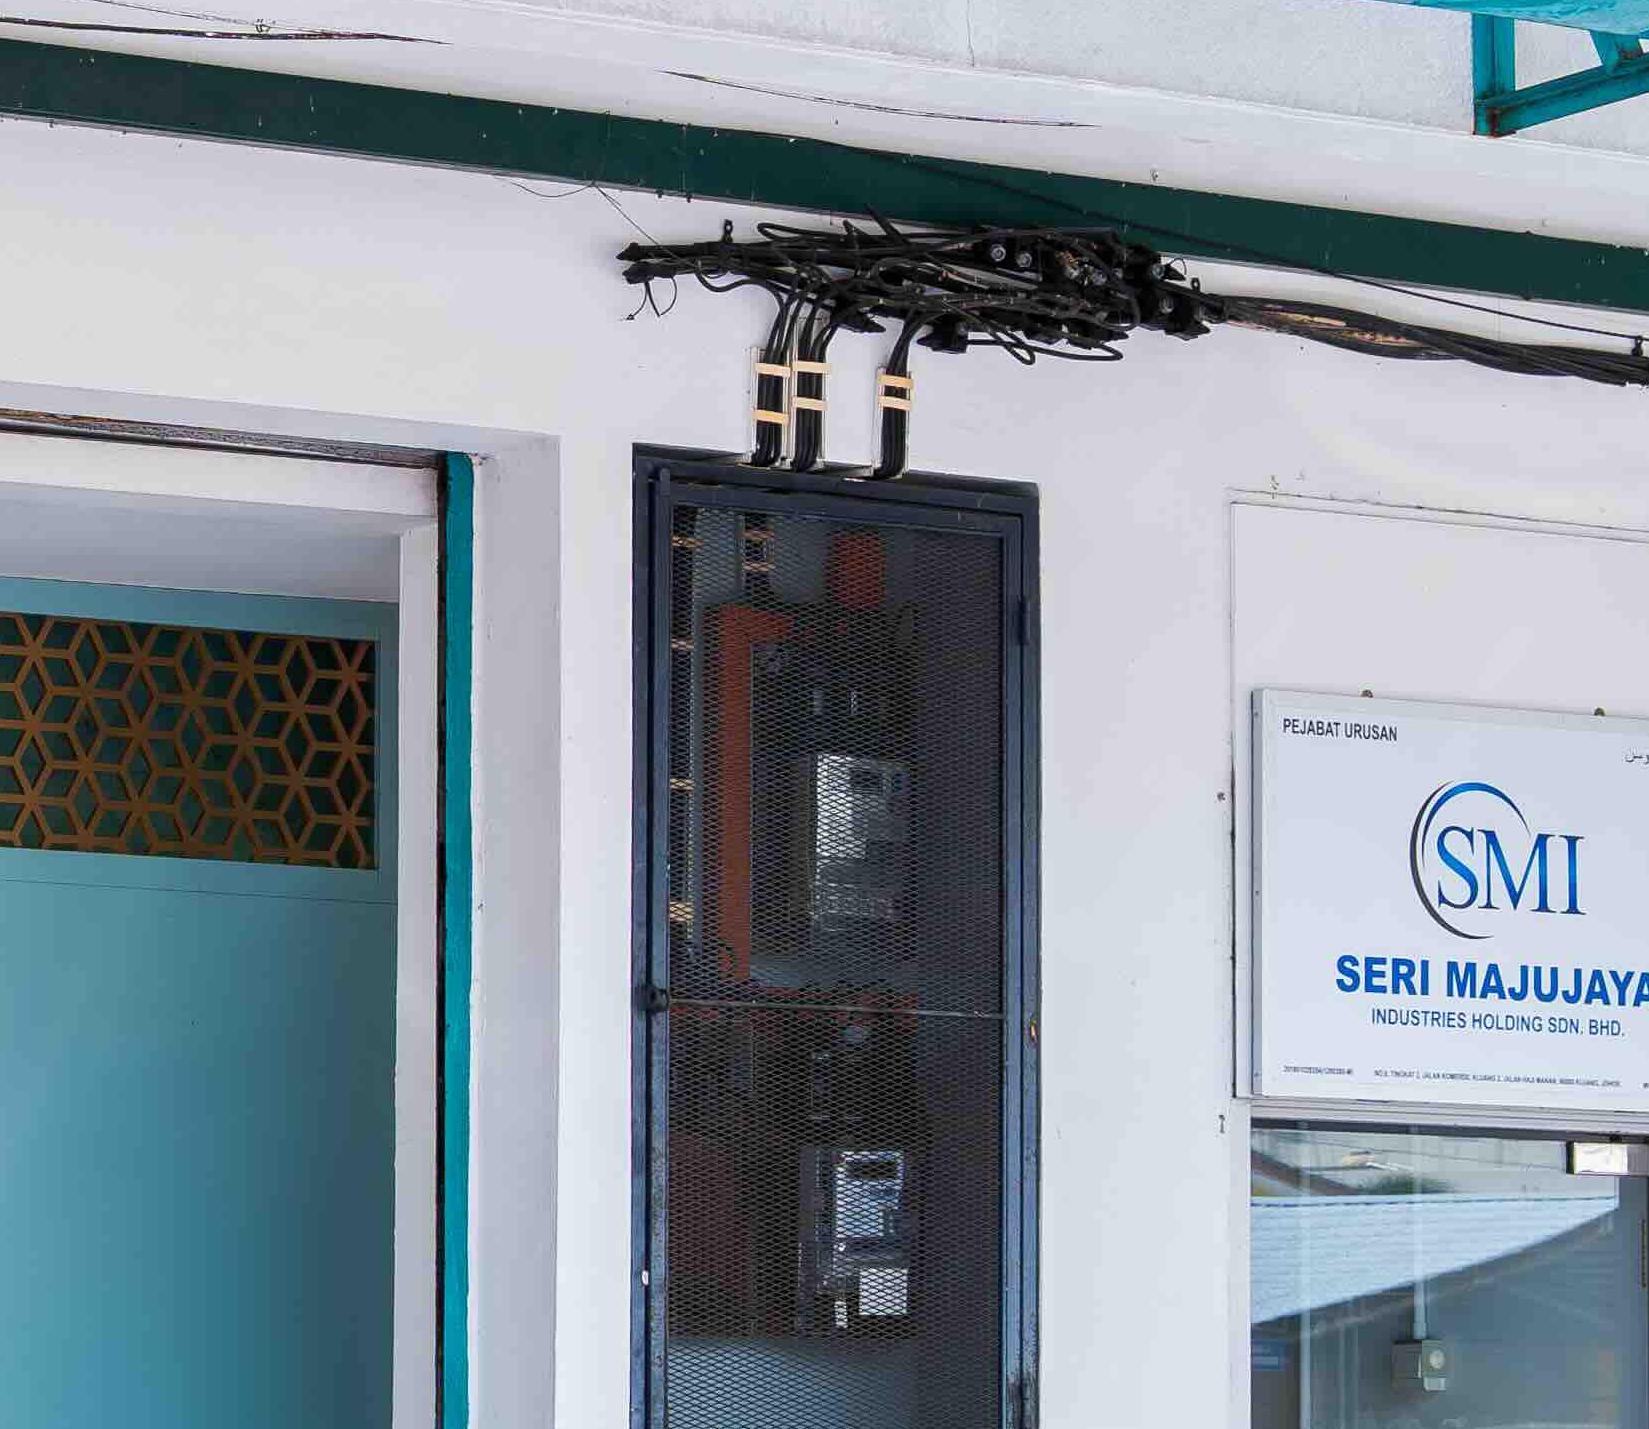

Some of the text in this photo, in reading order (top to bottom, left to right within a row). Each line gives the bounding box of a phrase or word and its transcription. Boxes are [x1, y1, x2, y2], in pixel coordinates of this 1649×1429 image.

[1283, 718, 1398, 742] PEJABAT URUSAN
[1436, 825, 1587, 915] SMI
[1336, 954, 1431, 997] SERI
[1371, 1008, 1626, 1038] INDUSTRIES HOLDING SDN. BHD.
